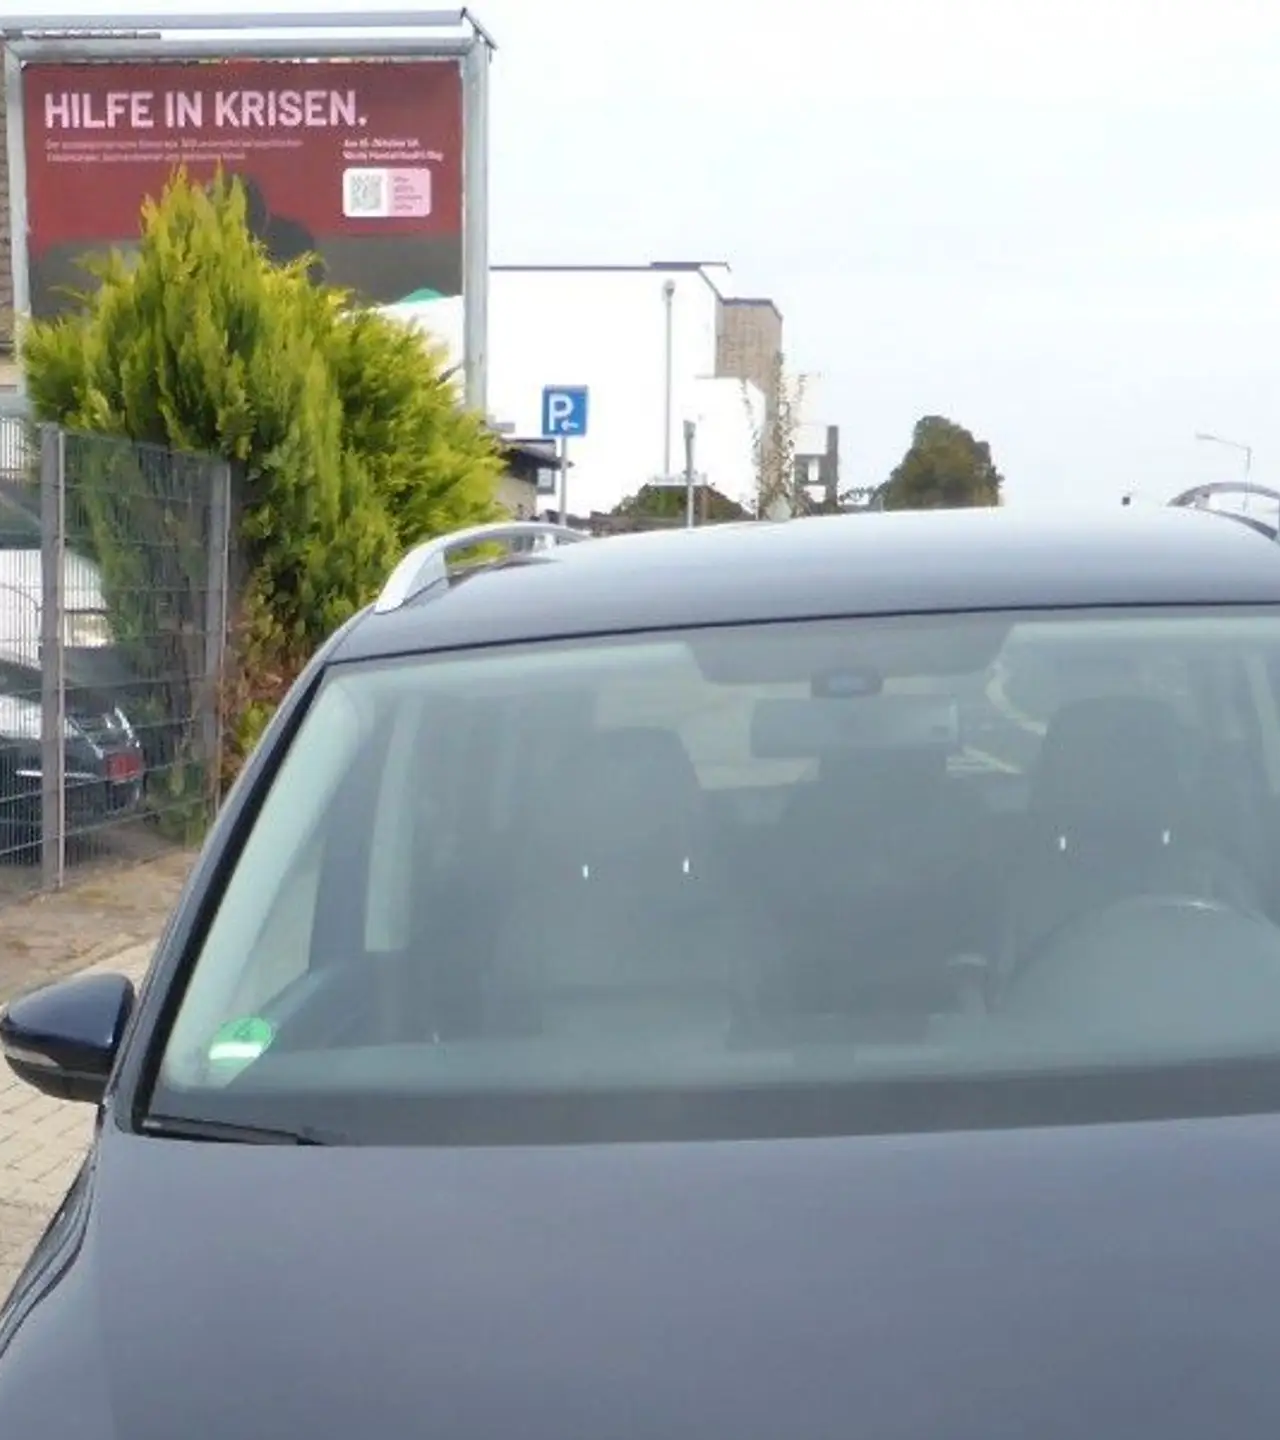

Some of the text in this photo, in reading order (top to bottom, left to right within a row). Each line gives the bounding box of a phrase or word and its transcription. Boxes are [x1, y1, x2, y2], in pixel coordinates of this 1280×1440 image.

[44, 90, 367, 129] HILFE IN KRISEN.
[549, 394, 574, 430] P
